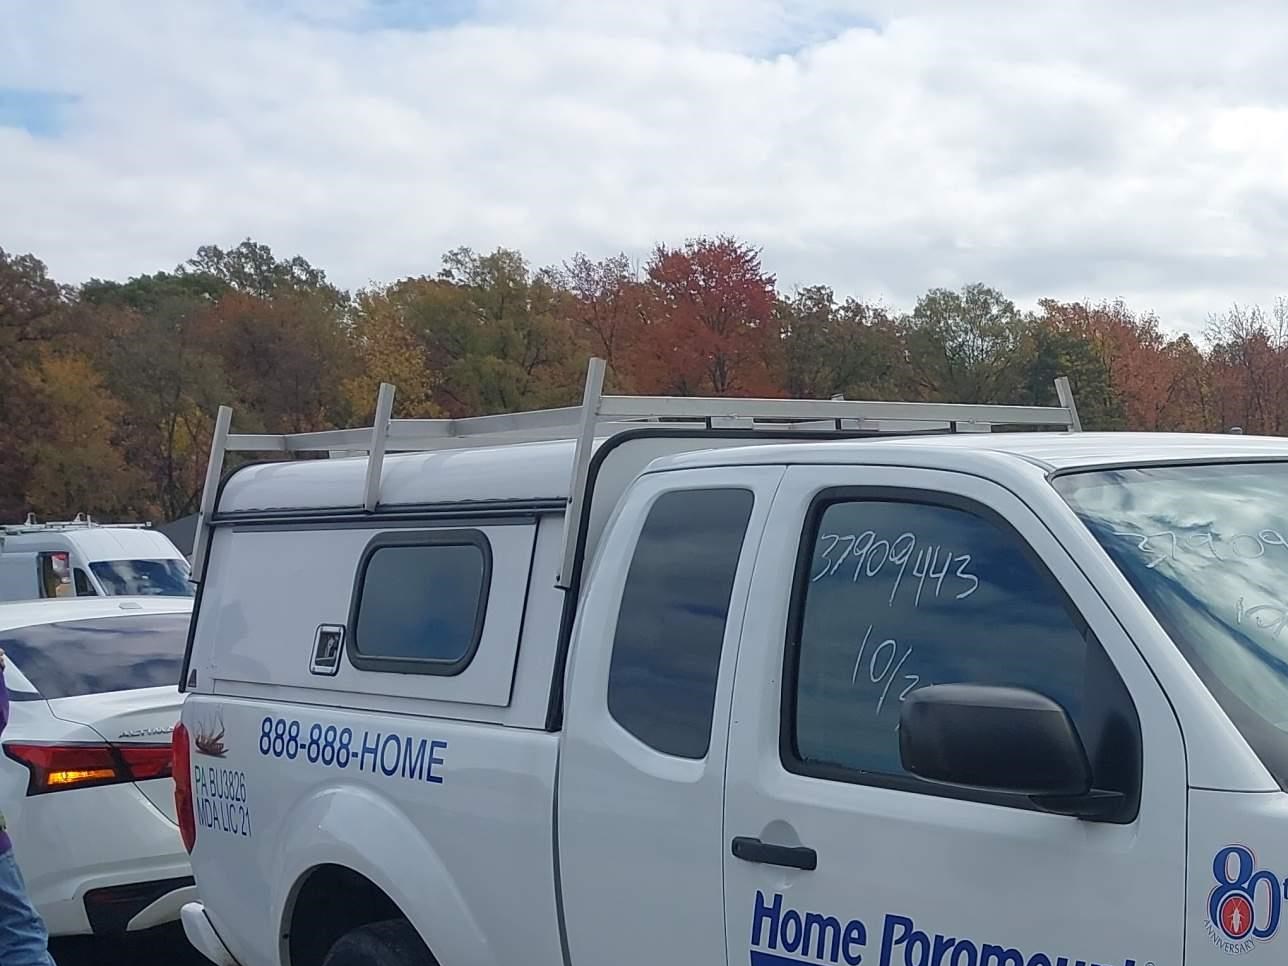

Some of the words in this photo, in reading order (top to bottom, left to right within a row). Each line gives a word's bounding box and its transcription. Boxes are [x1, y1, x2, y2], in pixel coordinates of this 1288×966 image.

[812, 531, 979, 607] 37909443
[259, 716, 448, 784] 888-888-HOME
[195, 765, 207, 796] PA
[209, 768, 247, 803] BU3826
[221, 803, 239, 836] LIC
[239, 807, 252, 837] 21
[751, 890, 867, 966] Home
[1204, 919, 1256, 954] ANNIVERSARY
